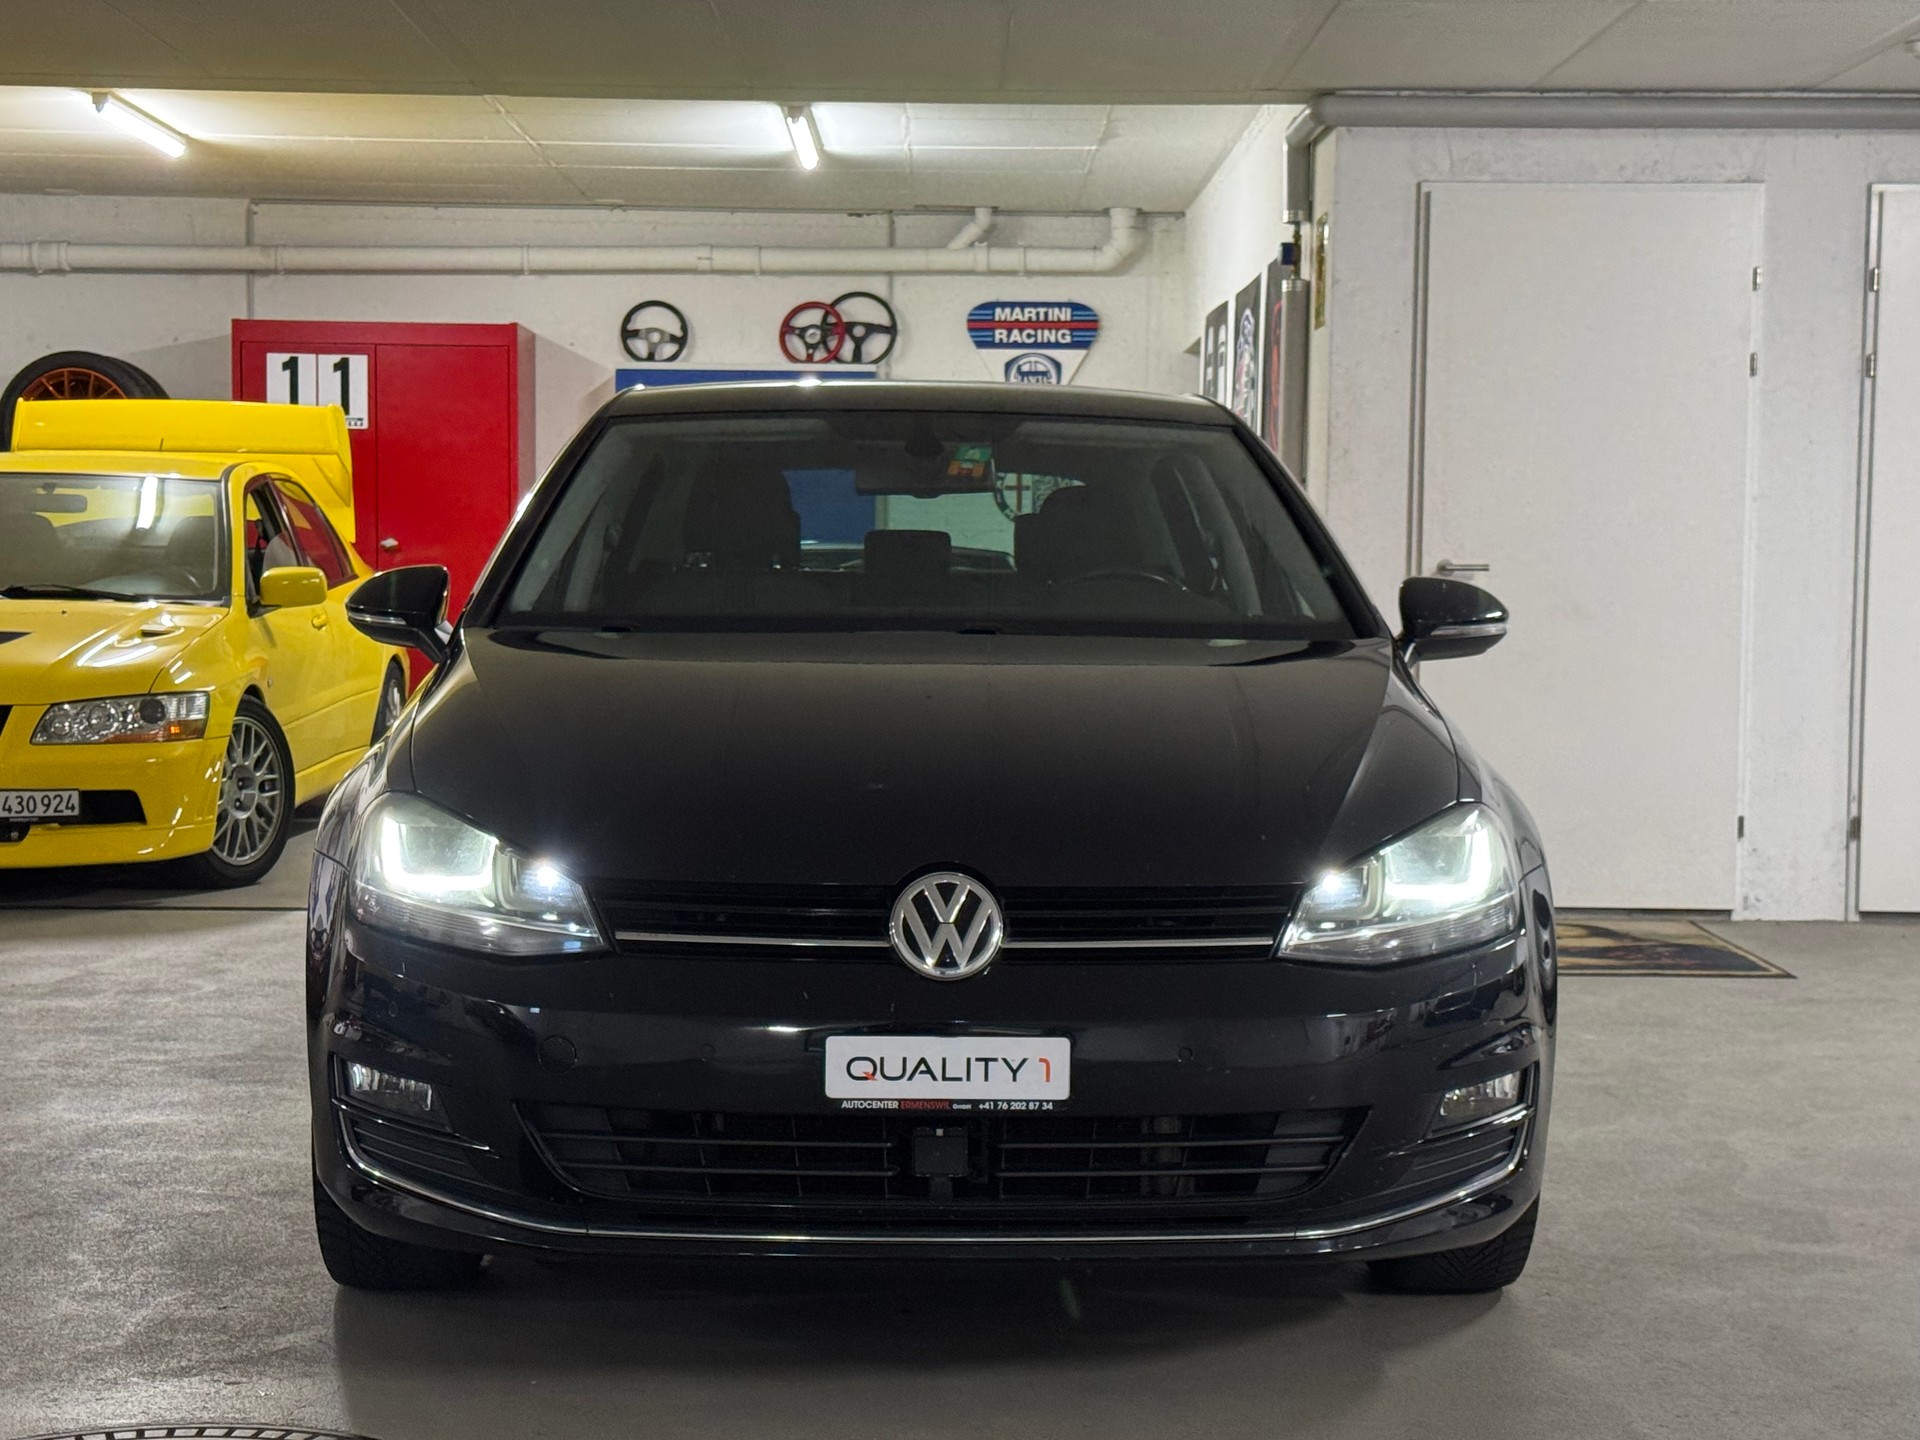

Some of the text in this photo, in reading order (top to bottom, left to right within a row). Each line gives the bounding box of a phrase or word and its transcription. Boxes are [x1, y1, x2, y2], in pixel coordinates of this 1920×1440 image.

[994, 307, 1072, 322] MARTINI
[994, 329, 1072, 343] RACING
[846, 1056, 1029, 1082] QUALITY
[841, 1101, 899, 1109] AUTOCENTER
[978, 1102, 994, 1110] +41
[997, 1102, 1009, 1110] 76
[1010, 1102, 1027, 1110] 202
[1028, 1102, 1040, 1110] 87
[1042, 1102, 1053, 1110] 34
